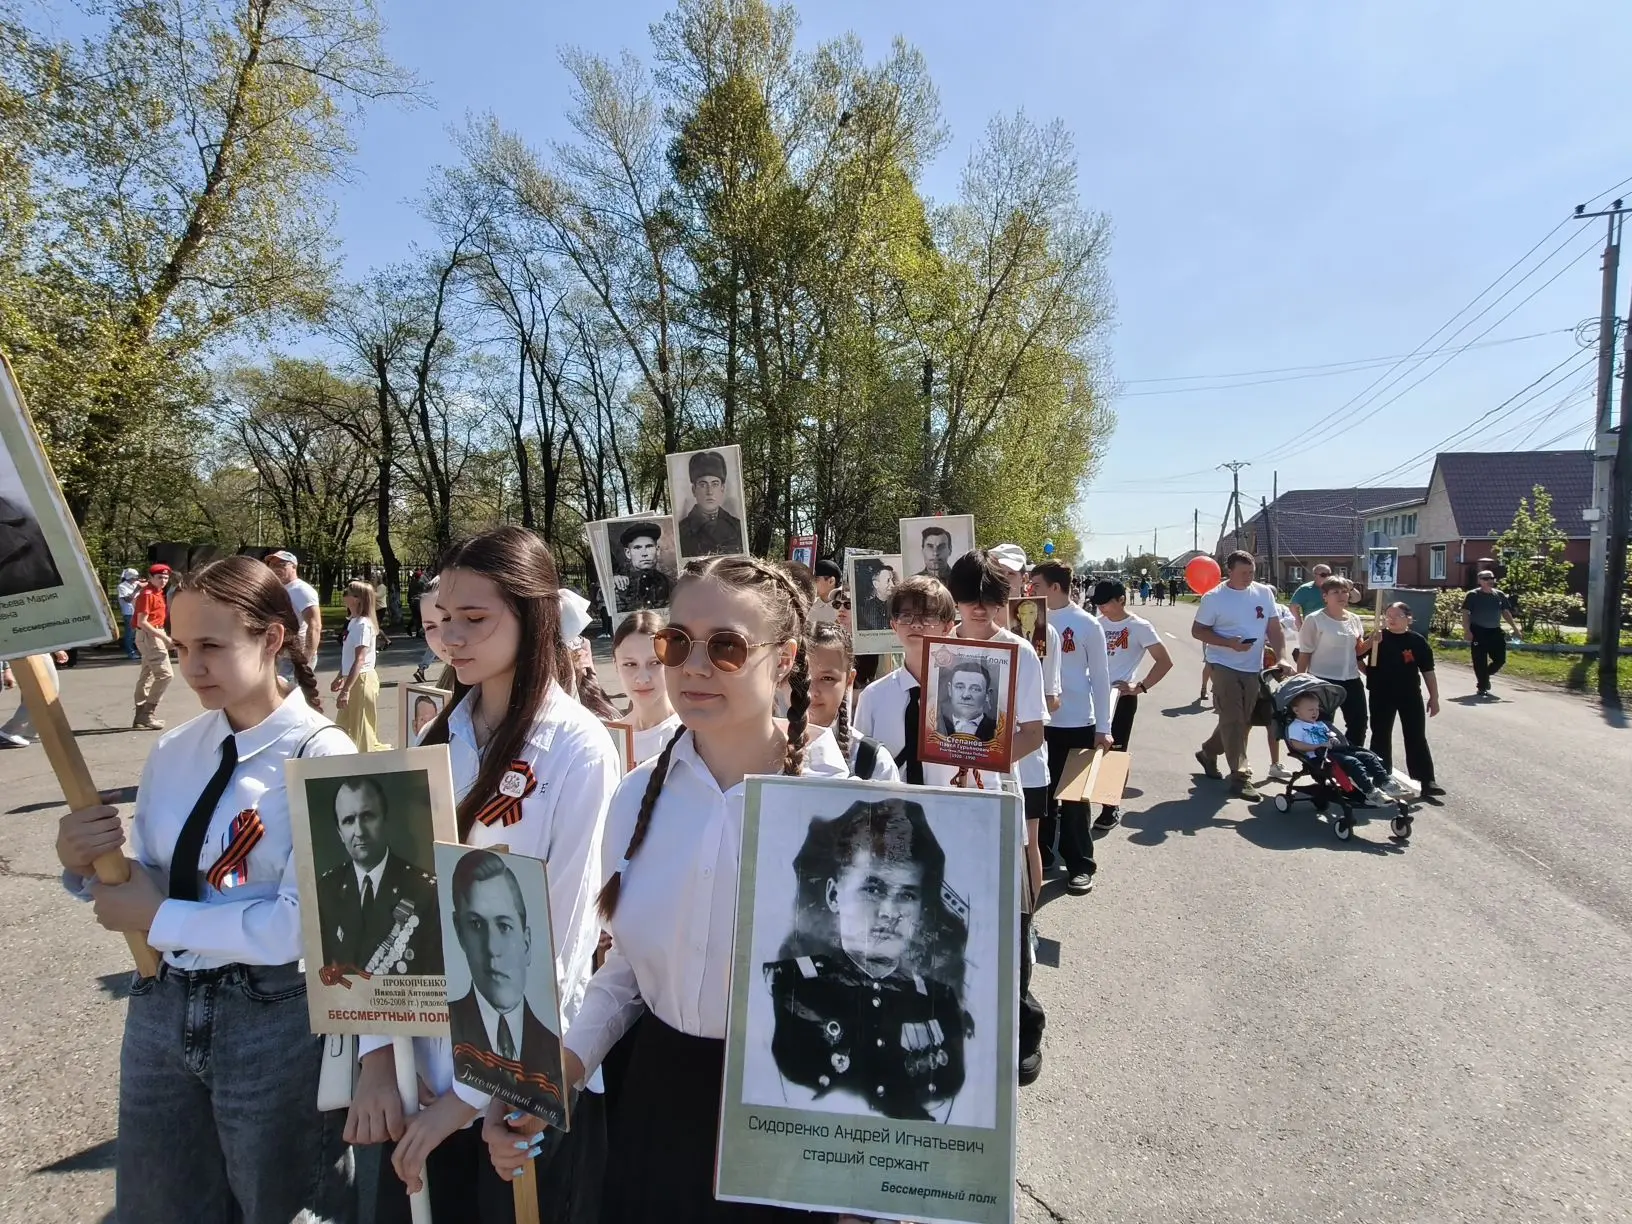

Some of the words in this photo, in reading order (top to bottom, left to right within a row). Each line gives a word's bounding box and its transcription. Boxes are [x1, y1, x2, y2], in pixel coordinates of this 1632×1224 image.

[27, 592, 59, 604] Мария
[12, 617, 70, 634] Бессмертный
[382, 978, 447, 988] ПРОКОПЧЕНКО
[374, 988, 406, 997] Николай
[407, 989, 448, 998] Антонович
[370, 998, 406, 1007] (1926-2008
[328, 1009, 416, 1022] БЕССМЕРТНЫЙ
[748, 1115, 830, 1138] Сидоренко
[834, 1123, 890, 1144] Андрей
[895, 1131, 984, 1154] Игнатьевич
[802, 1147, 865, 1165] старший
[869, 1155, 930, 1172] сержант
[880, 1181, 965, 1201] Бессмертный
[968, 1193, 998, 1205] полк
